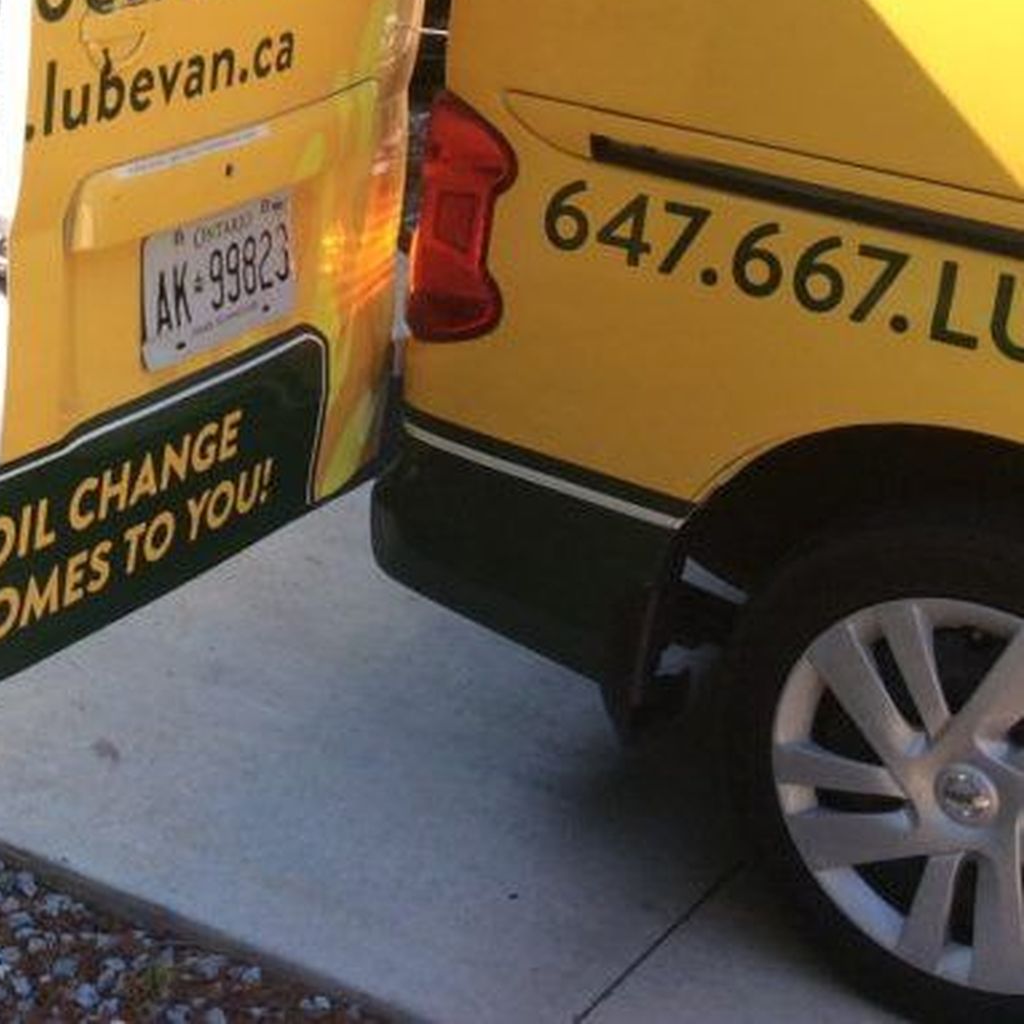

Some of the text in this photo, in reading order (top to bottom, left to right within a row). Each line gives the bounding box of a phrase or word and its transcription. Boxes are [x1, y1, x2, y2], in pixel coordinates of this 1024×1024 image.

[69, 410, 243, 532] CHANGE
[125, 510, 176, 575] TO
[186, 458, 275, 541] YOU!
